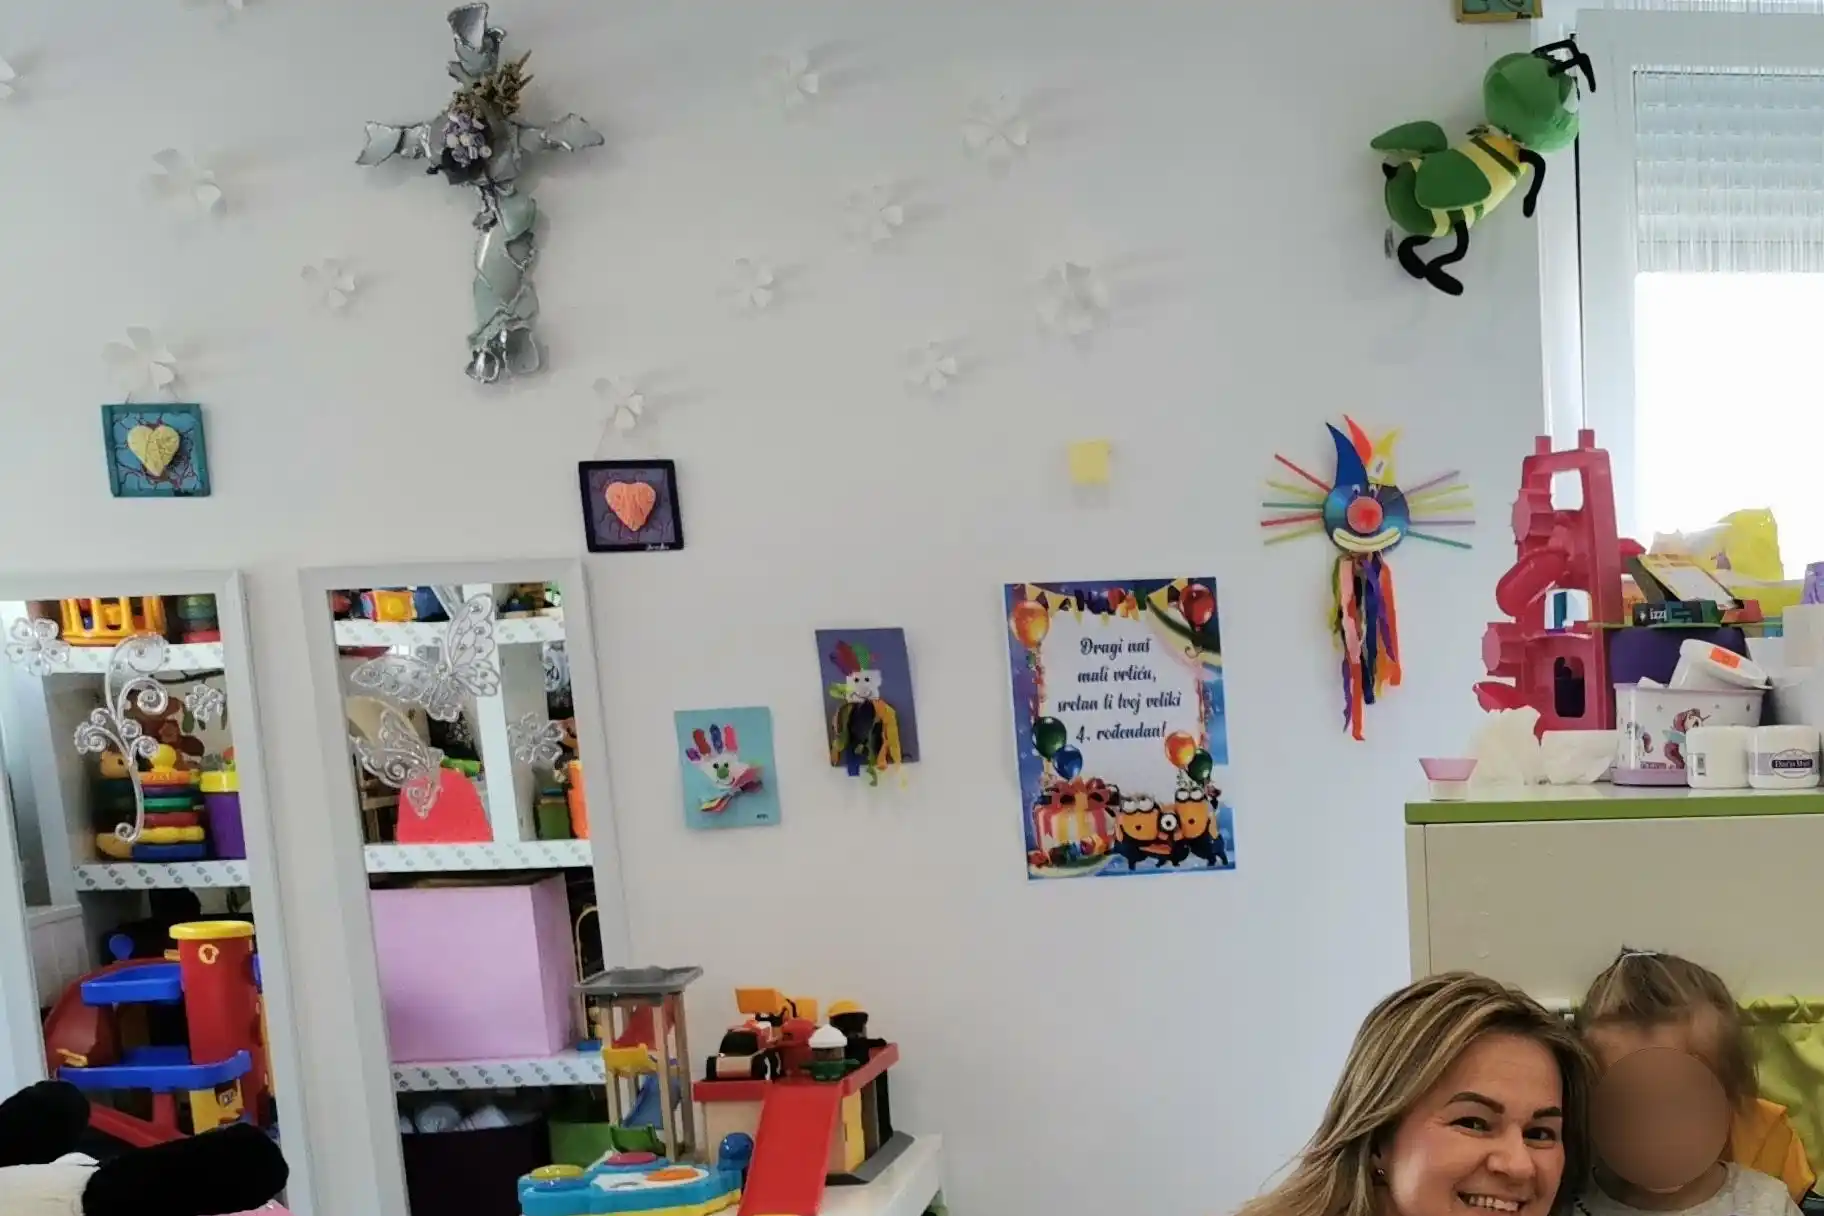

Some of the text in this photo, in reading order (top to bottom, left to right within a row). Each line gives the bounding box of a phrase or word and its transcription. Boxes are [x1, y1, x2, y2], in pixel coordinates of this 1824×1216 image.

[1077, 666, 1109, 683] mali
[1104, 693, 1114, 710] ti
[1147, 691, 1182, 708] veliki
[1075, 721, 1167, 744] 4. rođendan!
